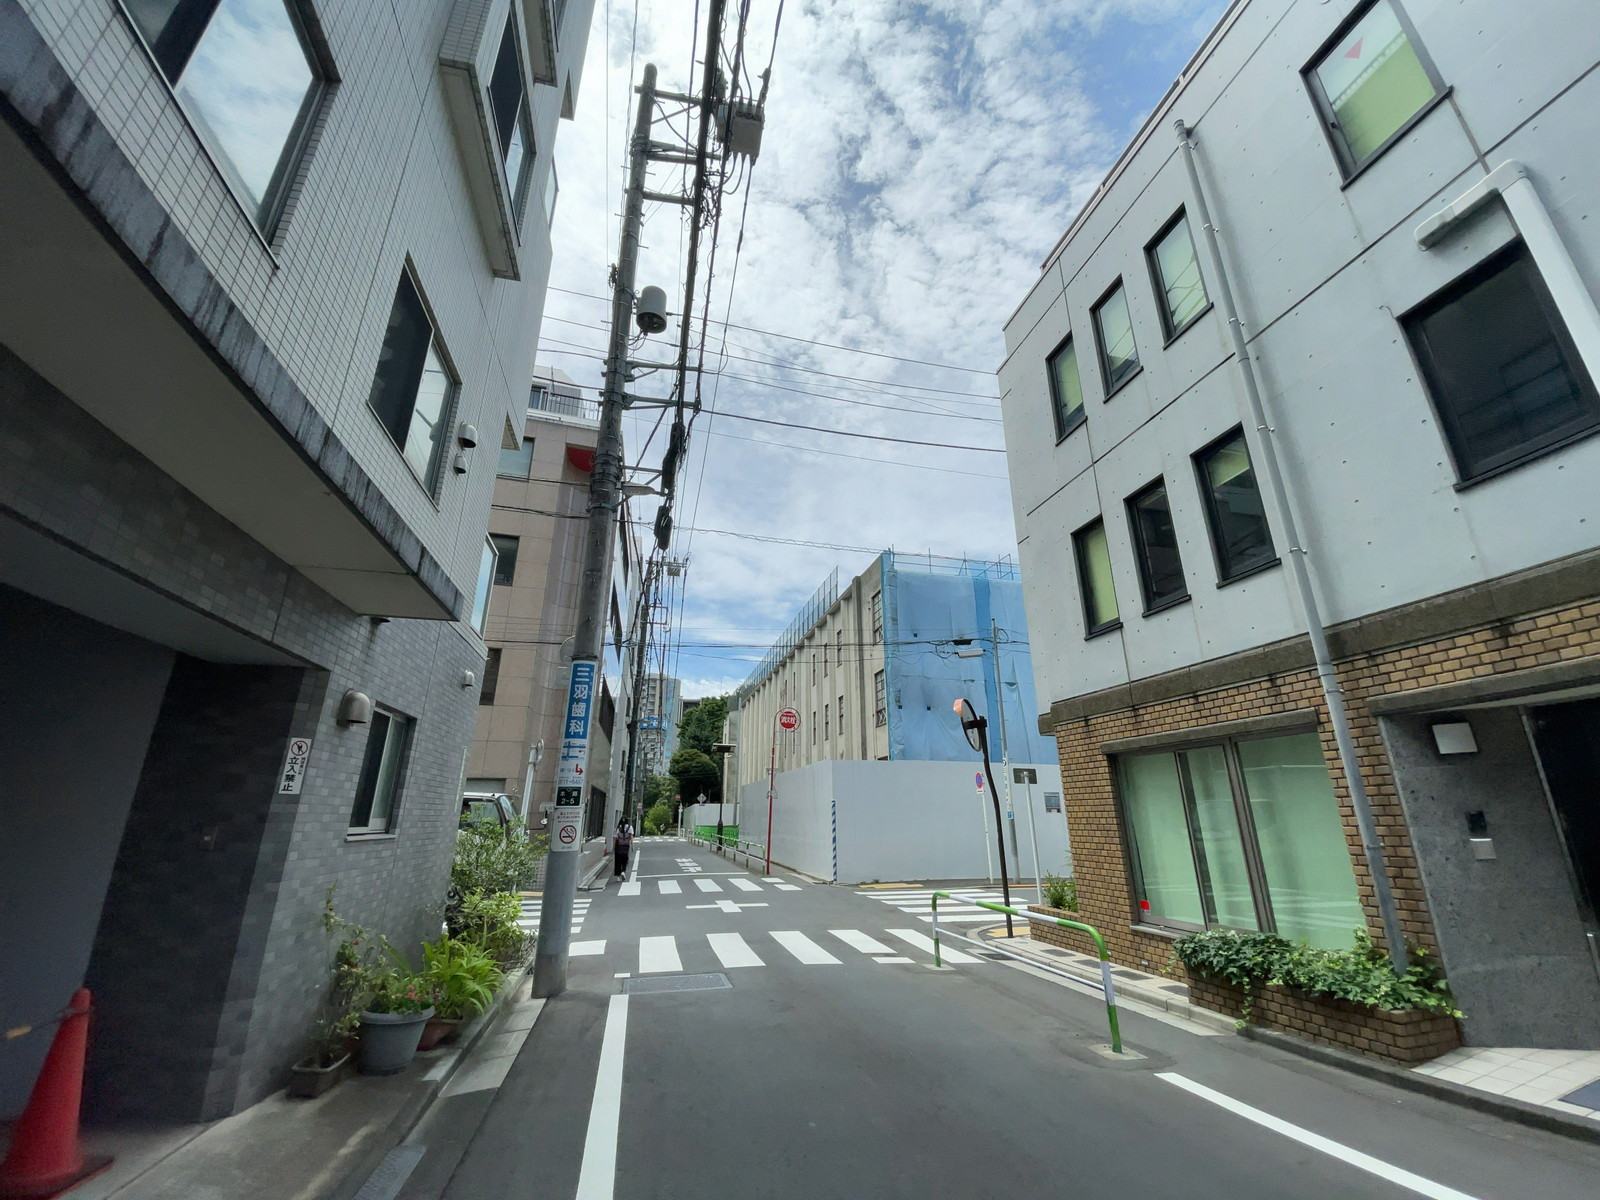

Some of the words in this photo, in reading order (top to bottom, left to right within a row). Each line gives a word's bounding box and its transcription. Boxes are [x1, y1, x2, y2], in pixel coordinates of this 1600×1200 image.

[568, 667, 590, 735] 三羽歯科
[281, 756, 300, 791] 立入禁止
[560, 797, 575, 805] 2-5
